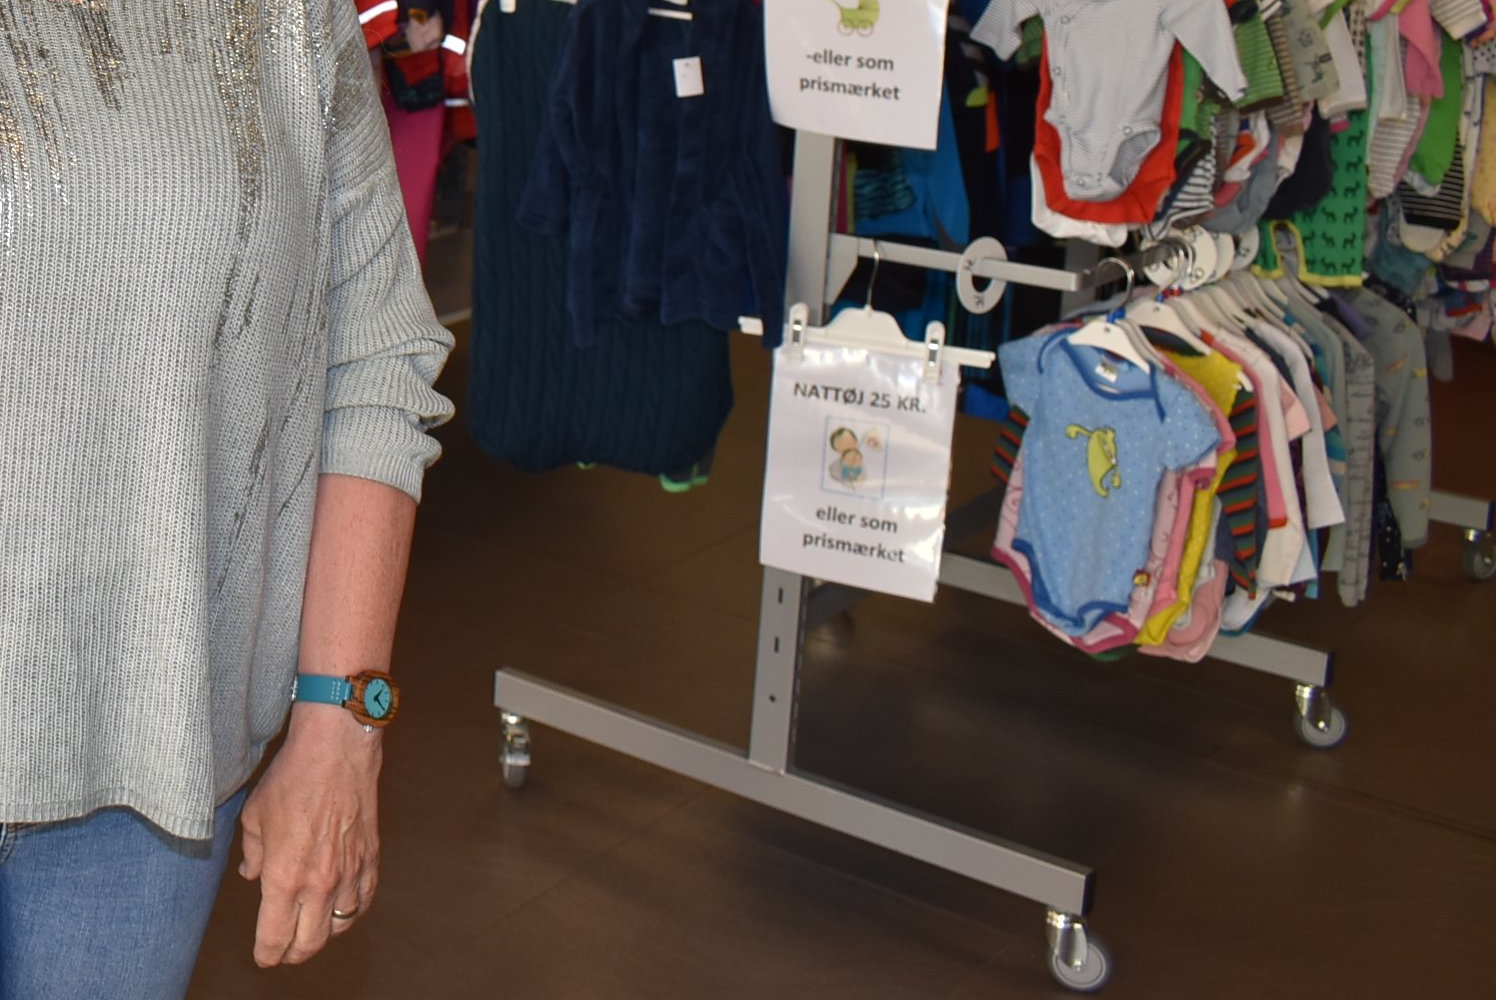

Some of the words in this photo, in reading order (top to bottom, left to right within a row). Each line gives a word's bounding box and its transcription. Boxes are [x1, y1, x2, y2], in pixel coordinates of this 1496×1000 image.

[856, 56, 894, 71] som
[799, 75, 901, 101] prismærket
[793, 382, 864, 406] NATTØJ
[870, 391, 891, 409] 25
[897, 394, 926, 414] KR.
[816, 506, 856, 526] eller
[860, 515, 898, 533] som
[803, 532, 905, 563] prismærket
